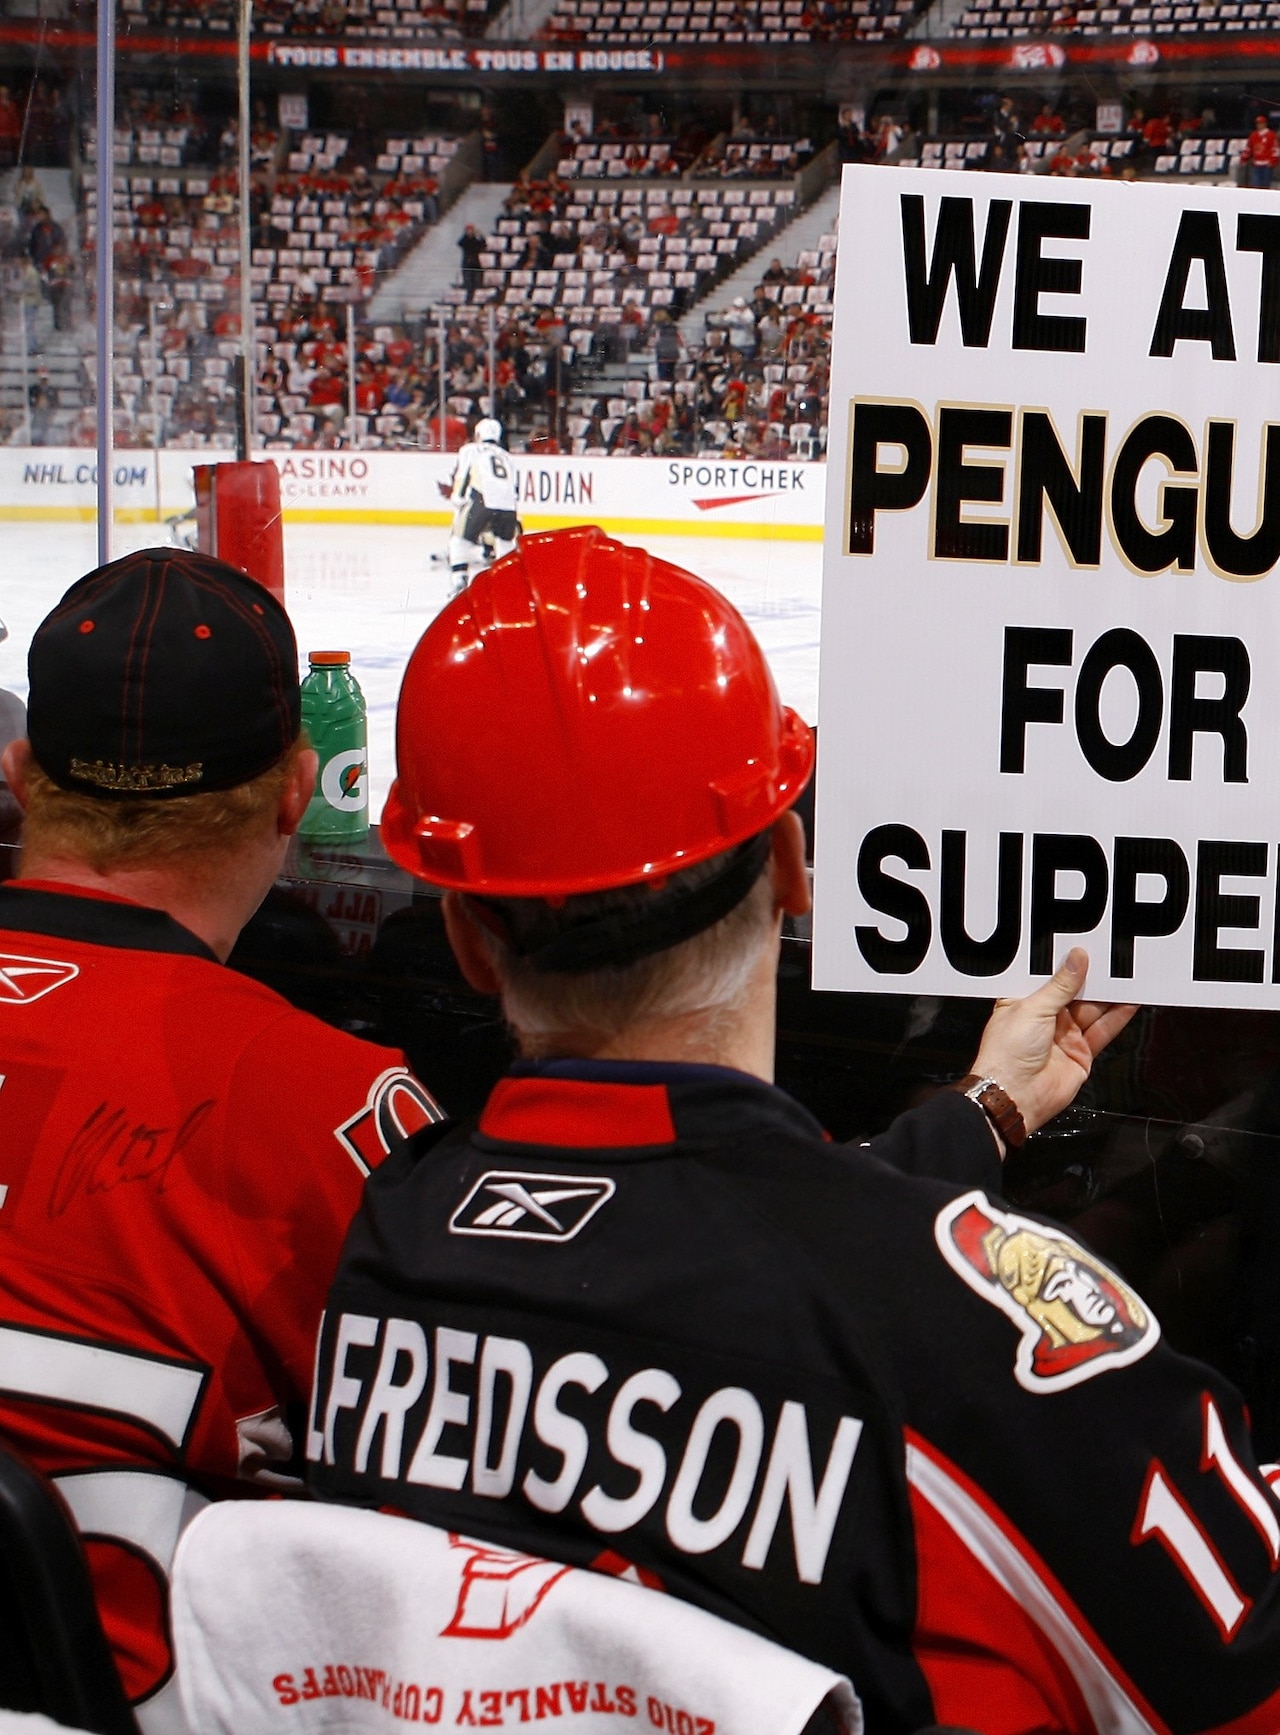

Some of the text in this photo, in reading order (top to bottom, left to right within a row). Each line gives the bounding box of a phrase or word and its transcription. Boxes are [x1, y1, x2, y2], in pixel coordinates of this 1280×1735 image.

[475, 51, 538, 72] TOUS
[899, 193, 1091, 353] WE
[280, 458, 368, 479] ASINO
[490, 455, 508, 480] 6
[515, 470, 593, 504] ADIAN
[1000, 625, 1251, 784] FOR
[456, 1679, 639, 1727] STANLEY
